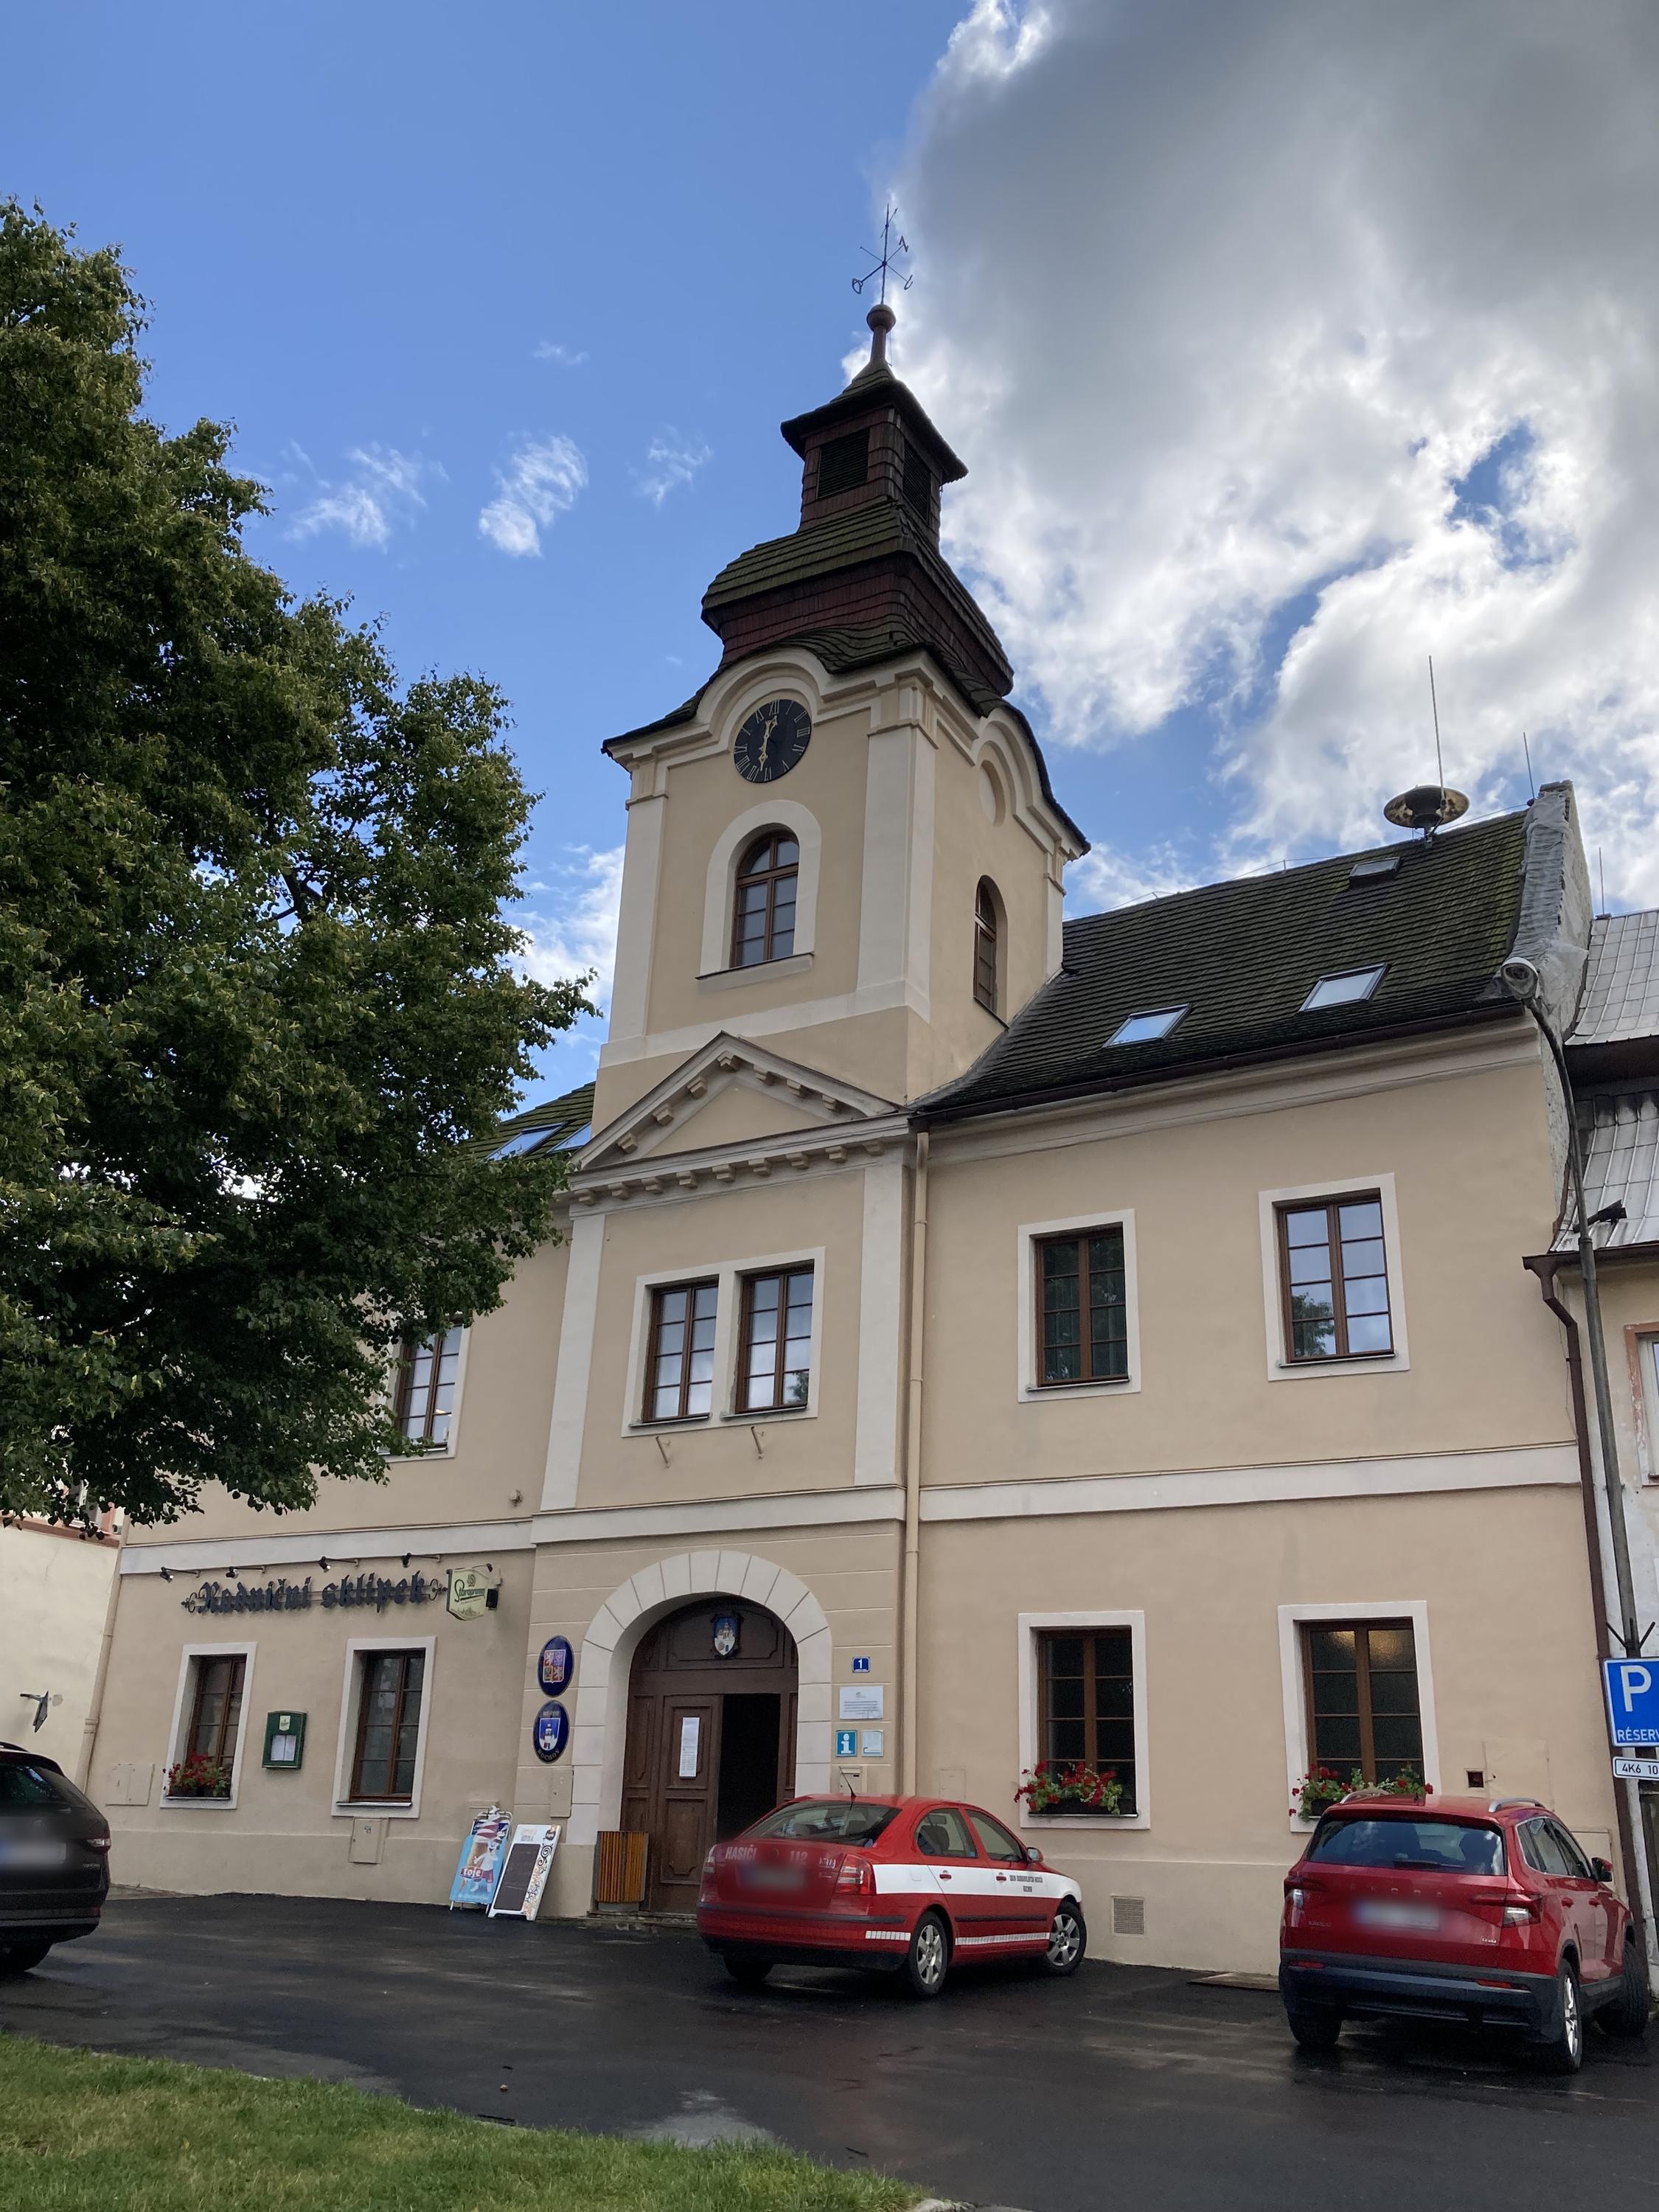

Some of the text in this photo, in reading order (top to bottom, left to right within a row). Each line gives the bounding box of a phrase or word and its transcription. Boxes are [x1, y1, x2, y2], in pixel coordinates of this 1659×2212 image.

[198, 1570, 427, 1614] Radniční sklípek
[858, 1658, 863, 1669] 1
[1619, 1665, 1652, 1712] P
[1621, 1763, 1659, 1775] 4K6 10
[725, 1844, 758, 1861] HASIČI
[790, 1850, 809, 1865] 112
